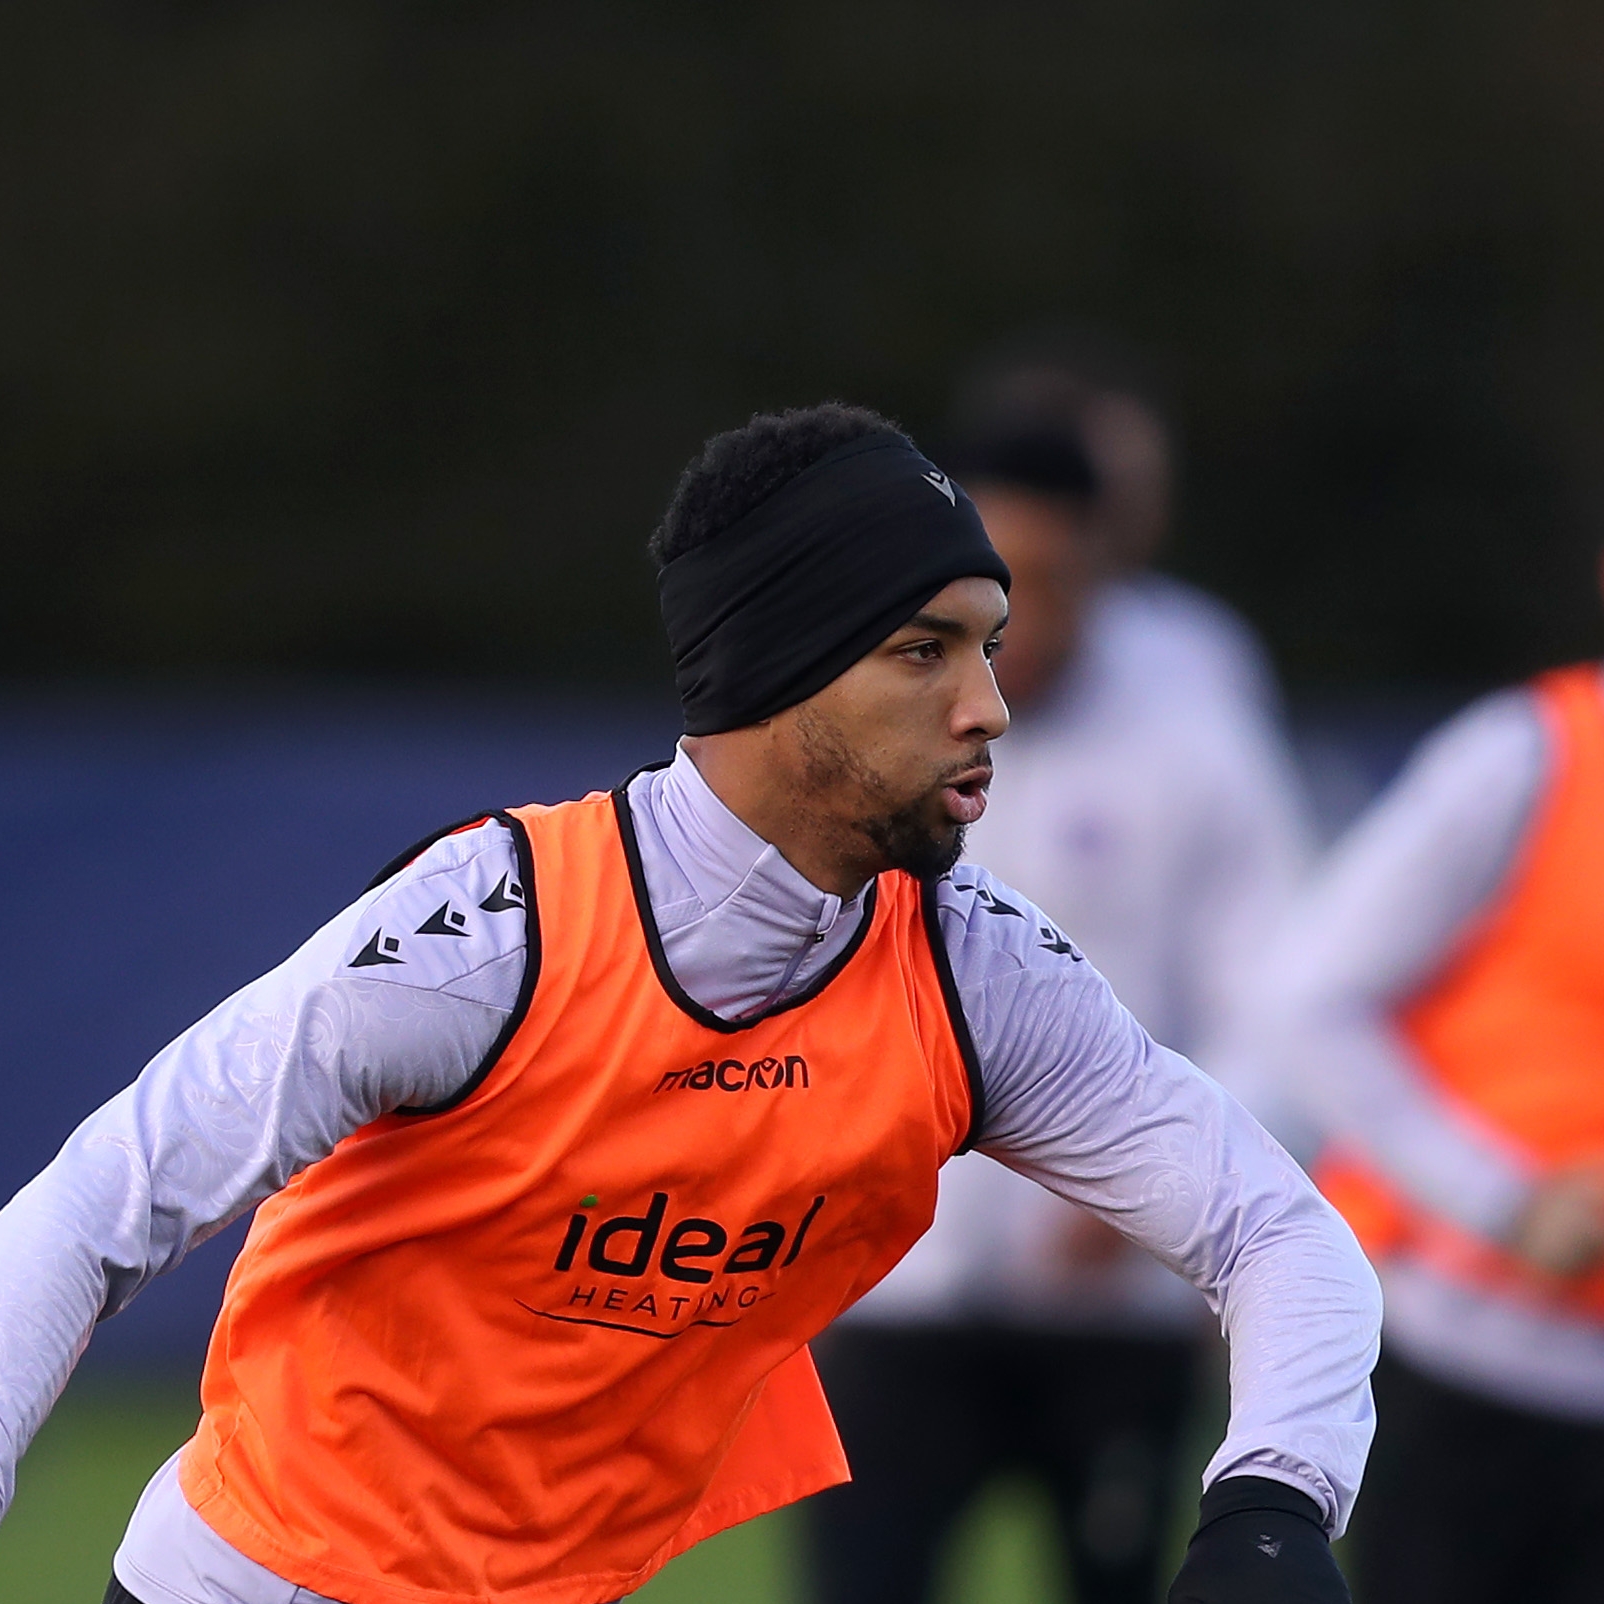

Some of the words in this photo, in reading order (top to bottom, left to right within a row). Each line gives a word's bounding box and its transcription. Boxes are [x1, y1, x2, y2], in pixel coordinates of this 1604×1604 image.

[652, 1055, 809, 1094] macron
[554, 1191, 825, 1284] ideal
[568, 1285, 761, 1320] HEATING
